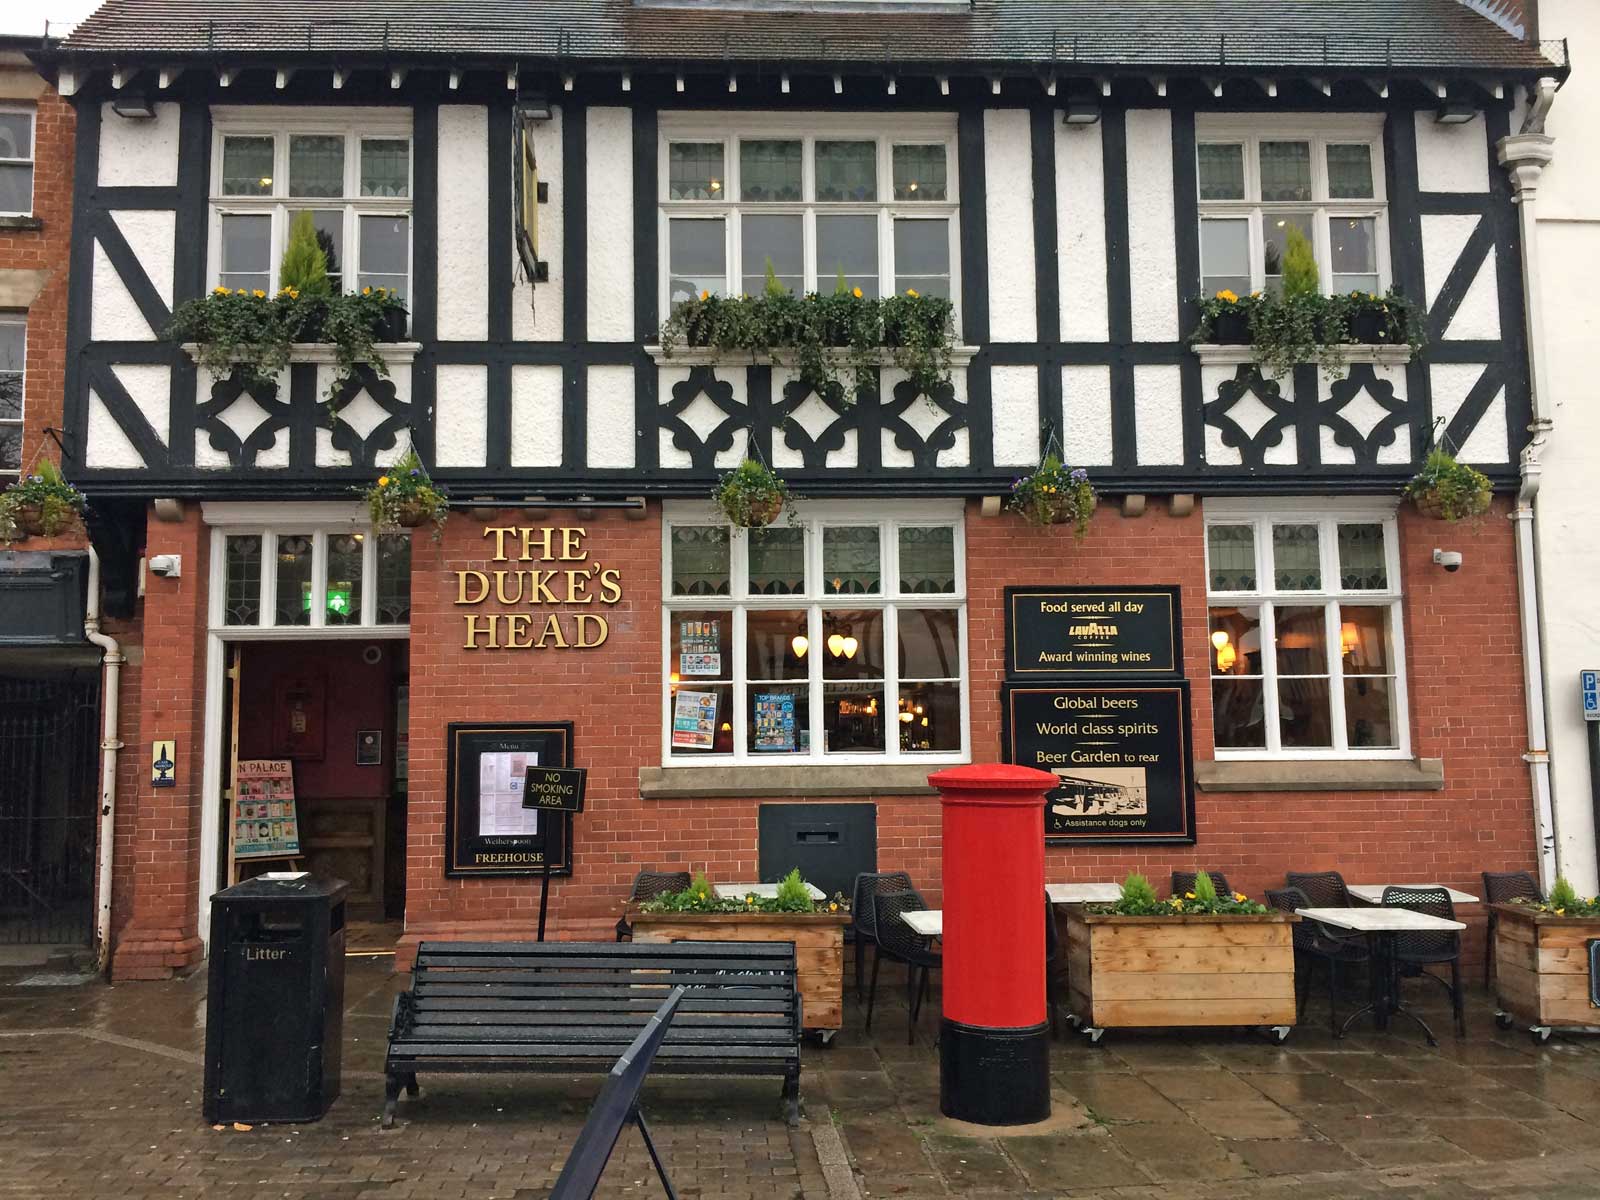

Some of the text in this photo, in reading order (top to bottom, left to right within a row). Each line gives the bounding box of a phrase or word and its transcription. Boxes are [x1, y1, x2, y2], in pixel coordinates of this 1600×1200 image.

[483, 526, 588, 561] THE
[454, 562, 622, 604] DUKE'S
[1041, 602, 1144, 614] Food served all day
[463, 613, 609, 648] HEAD
[1069, 622, 1118, 635] LAVAZZA
[1038, 651, 1151, 663] Award winning wines
[1054, 697, 1139, 709] Global beers
[1036, 723, 1159, 737] World class spirits
[1036, 751, 1067, 763] Beer
[1071, 751, 1121, 763] Garden
[1138, 754, 1159, 762] rear
[250, 763, 287, 772] PALACE
[545, 773, 561, 783] NO
[531, 783, 573, 795] SMOKING
[539, 796, 562, 806] AREA
[1065, 819, 1147, 829] Assistance dogs only
[475, 853, 544, 863] FREEHOUSE
[246, 947, 286, 960] Litter
